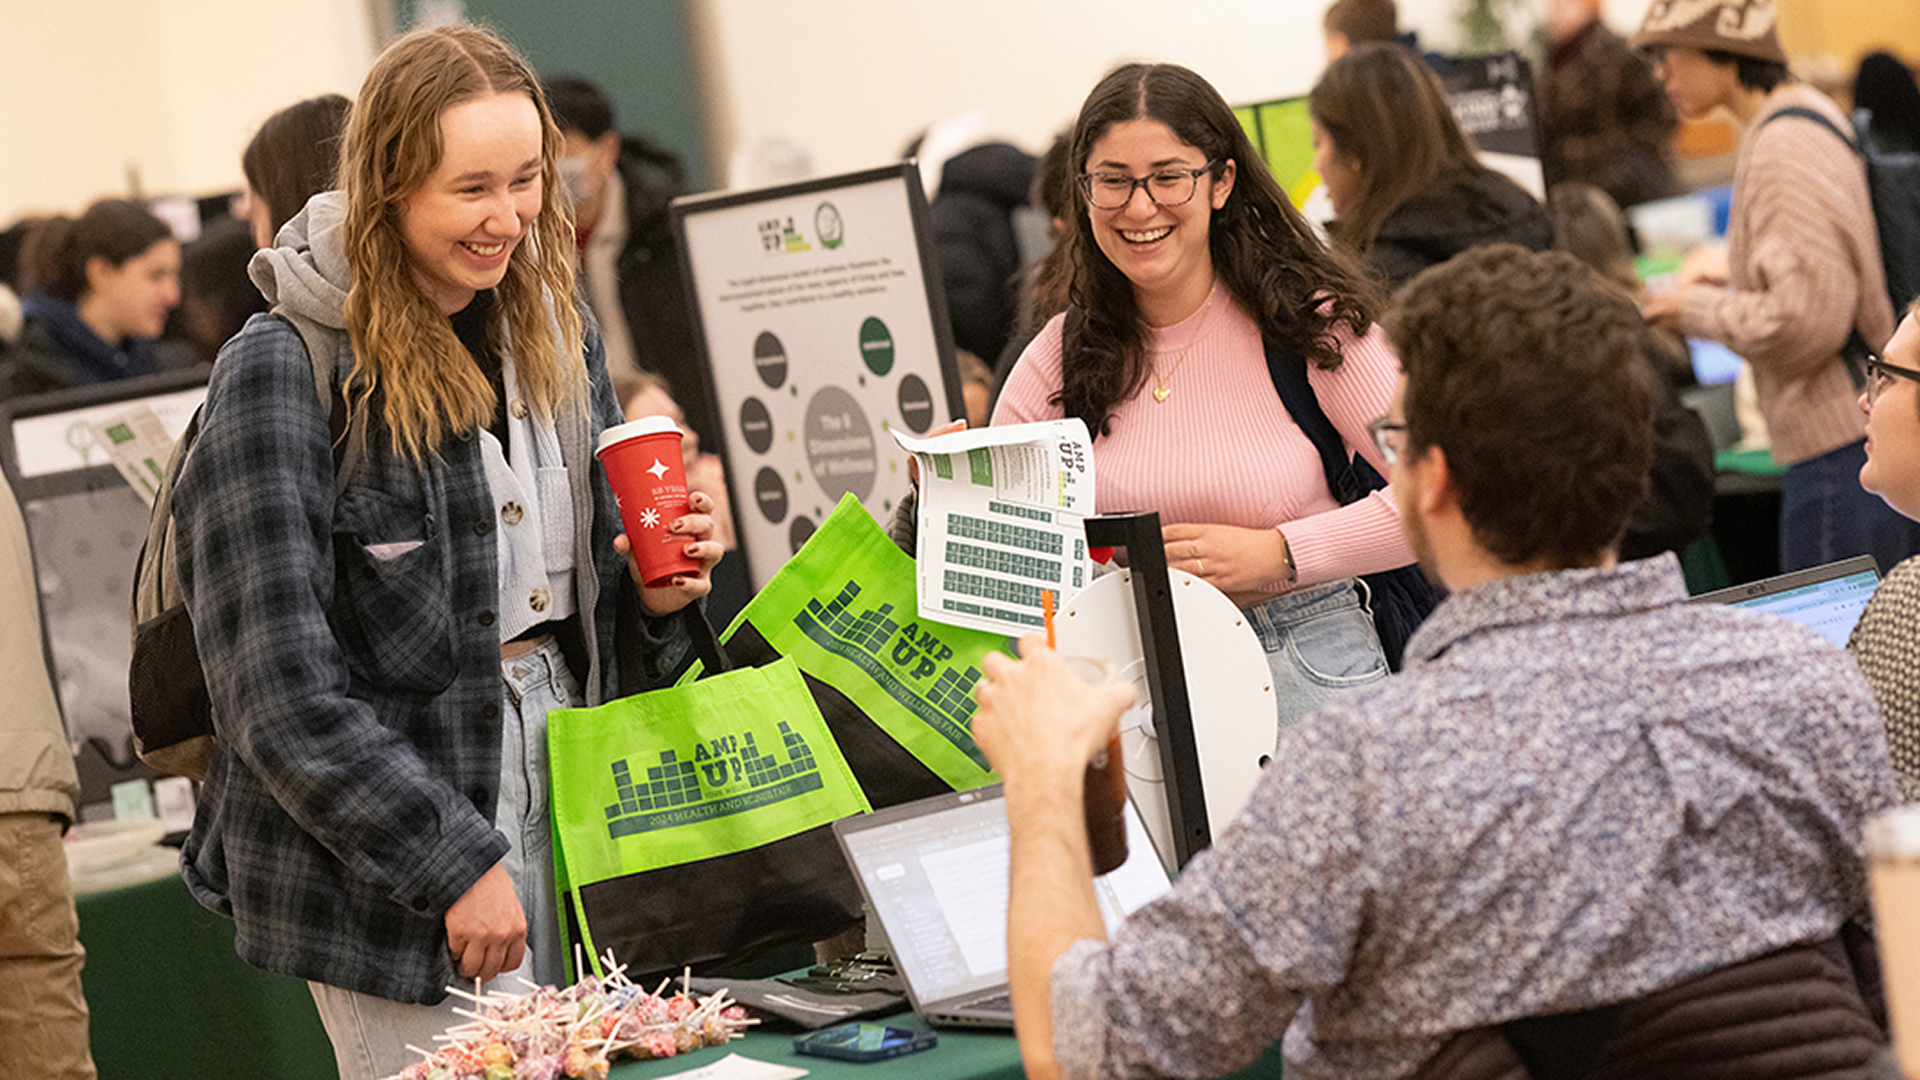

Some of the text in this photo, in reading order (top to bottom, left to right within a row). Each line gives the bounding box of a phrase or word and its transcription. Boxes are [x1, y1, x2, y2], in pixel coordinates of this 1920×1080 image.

[1059, 442, 1074, 469] UP
[1072, 441, 1085, 473] AMP
[891, 637, 936, 681] UP
[901, 622, 953, 662] AMP
[845, 644, 879, 675] HEALTH
[877, 671, 899, 691] AND
[897, 687, 943, 725] WELLNESS
[941, 720, 963, 741] FAIR
[695, 734, 738, 762] AMP
[701, 756, 742, 787] UP
[650, 813, 673, 826] 2024
[673, 802, 720, 822] HEALTH
[719, 797, 742, 812] AND
[772, 784, 793, 799] FAIR
